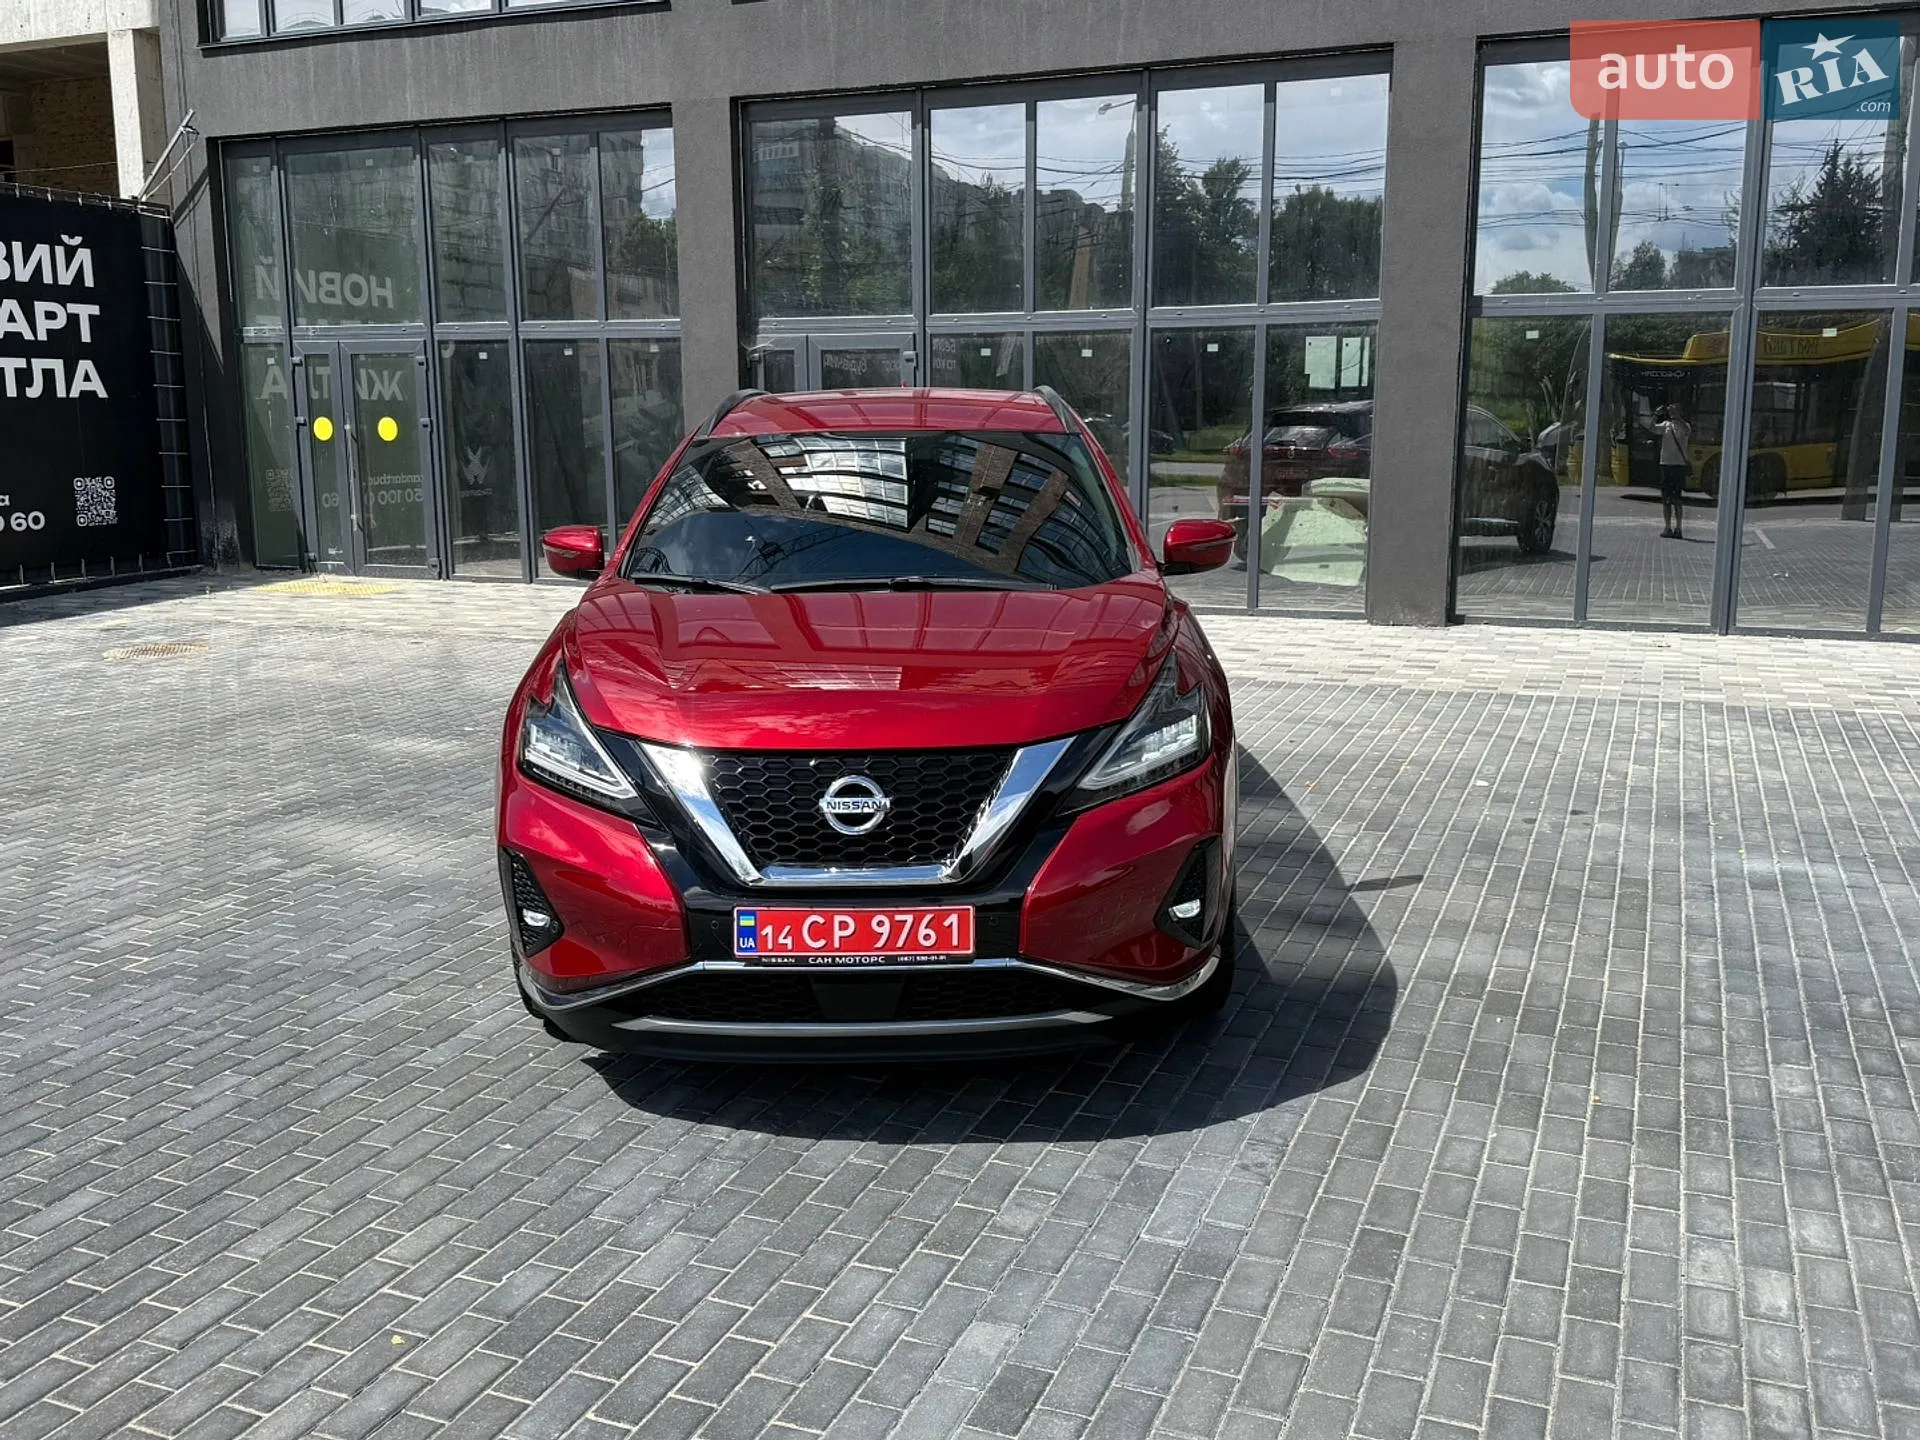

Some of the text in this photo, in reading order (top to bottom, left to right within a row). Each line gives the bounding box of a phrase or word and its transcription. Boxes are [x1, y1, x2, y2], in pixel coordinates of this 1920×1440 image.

[826, 801, 881, 810] NISSAN
[760, 925, 793, 950] 14
[871, 913, 959, 948] 9761
[740, 938, 755, 948] UA
